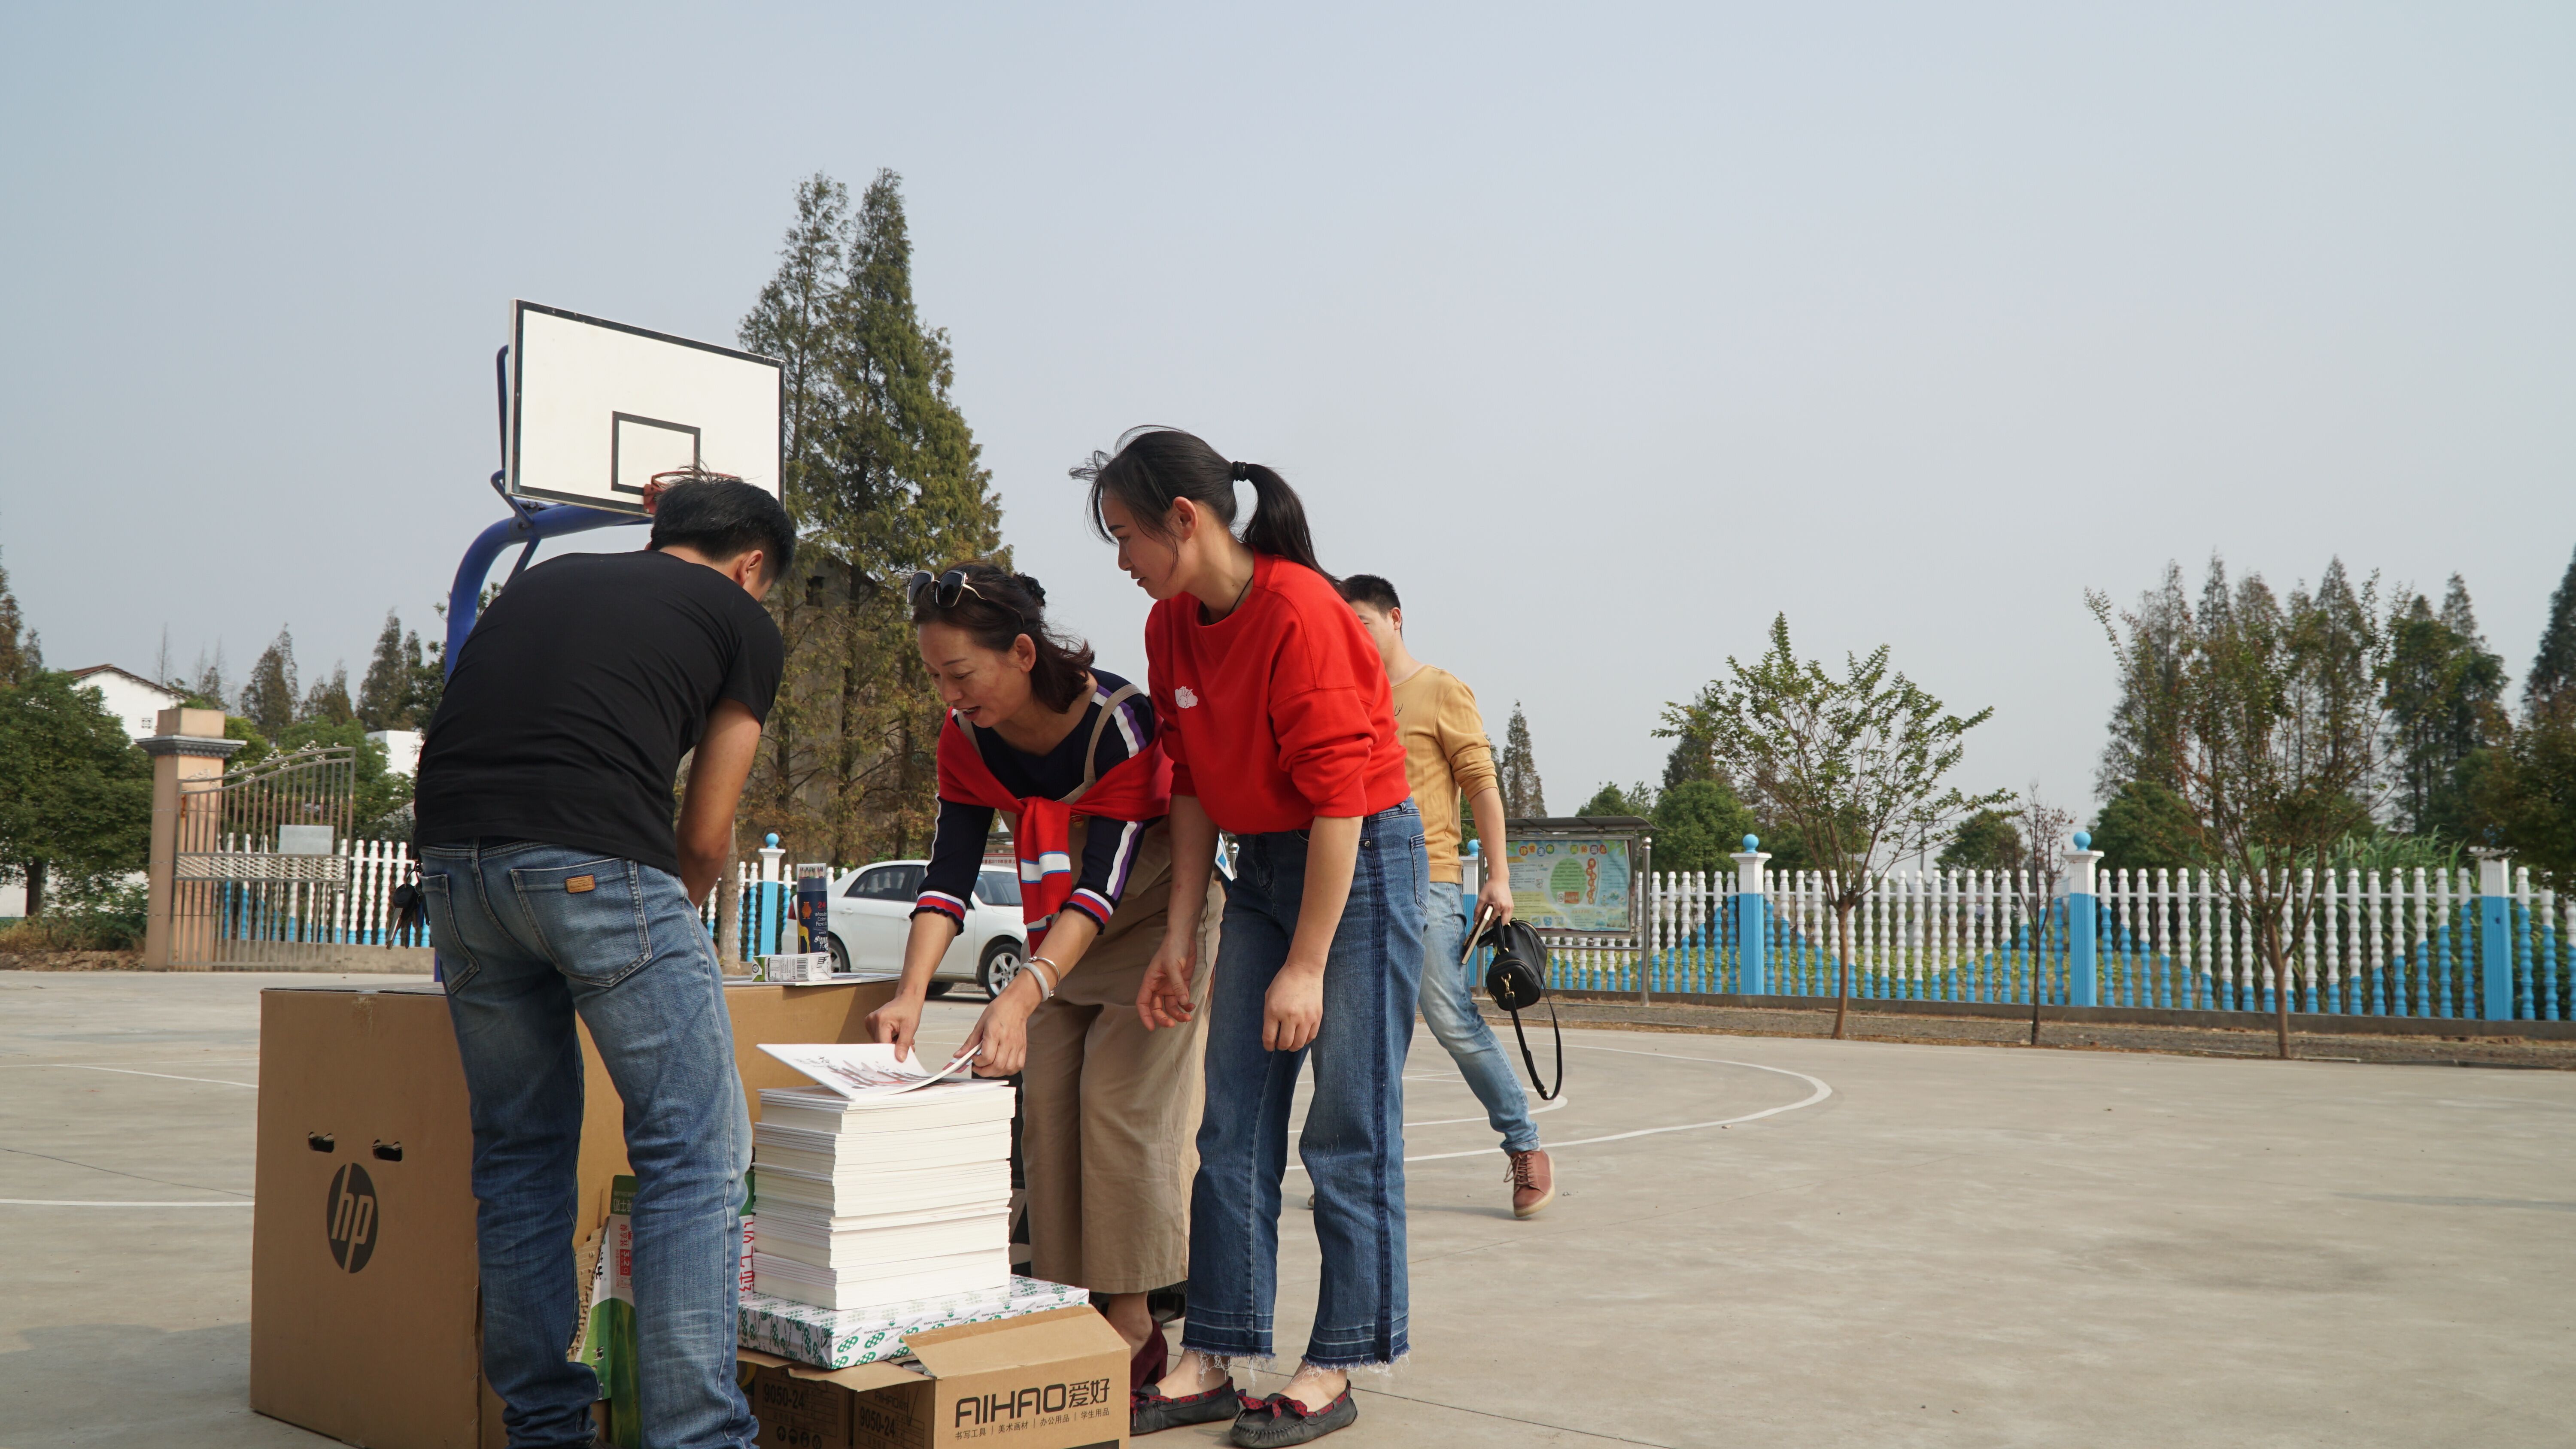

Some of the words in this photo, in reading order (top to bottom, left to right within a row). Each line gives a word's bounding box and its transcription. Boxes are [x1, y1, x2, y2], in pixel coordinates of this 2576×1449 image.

[331, 1162, 374, 1273] hp
[764, 1383, 805, 1410] 9050-24
[955, 1383, 1066, 1428] AIHAO
[1068, 1378, 1110, 1408] 爱好
[860, 1406, 895, 1439] 9050-24
[955, 1428, 986, 1441] 书写工具
[998, 1419, 1029, 1434] 美术画材
[1040, 1413, 1070, 1427] 办公用品
[1081, 1407, 1110, 1419] 学生用品
